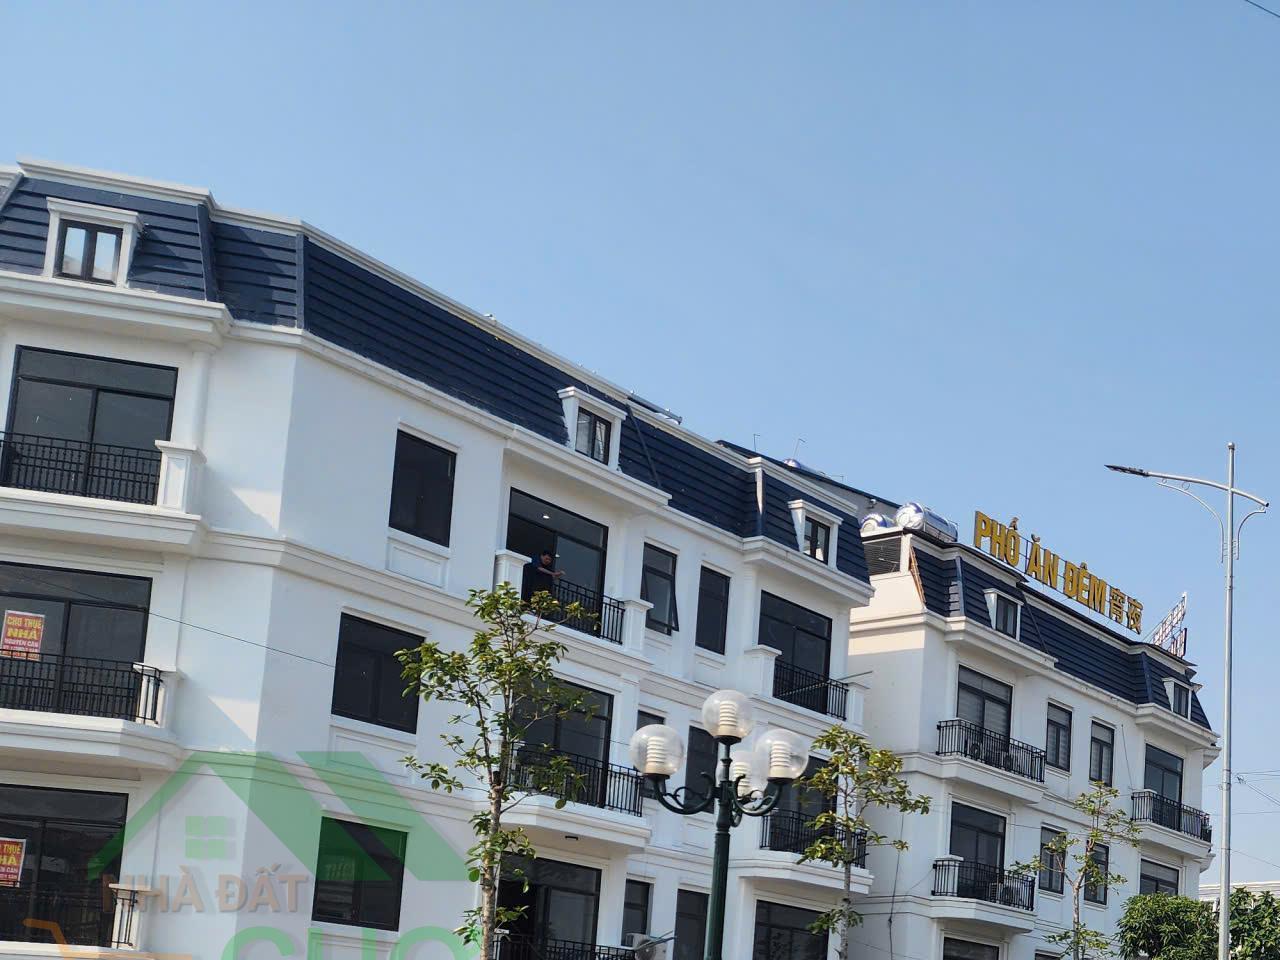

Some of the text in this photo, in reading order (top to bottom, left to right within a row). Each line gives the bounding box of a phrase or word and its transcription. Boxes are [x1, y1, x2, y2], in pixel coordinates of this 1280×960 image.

[975, 511, 1107, 615] PHỐ ĂN ĐÊM
